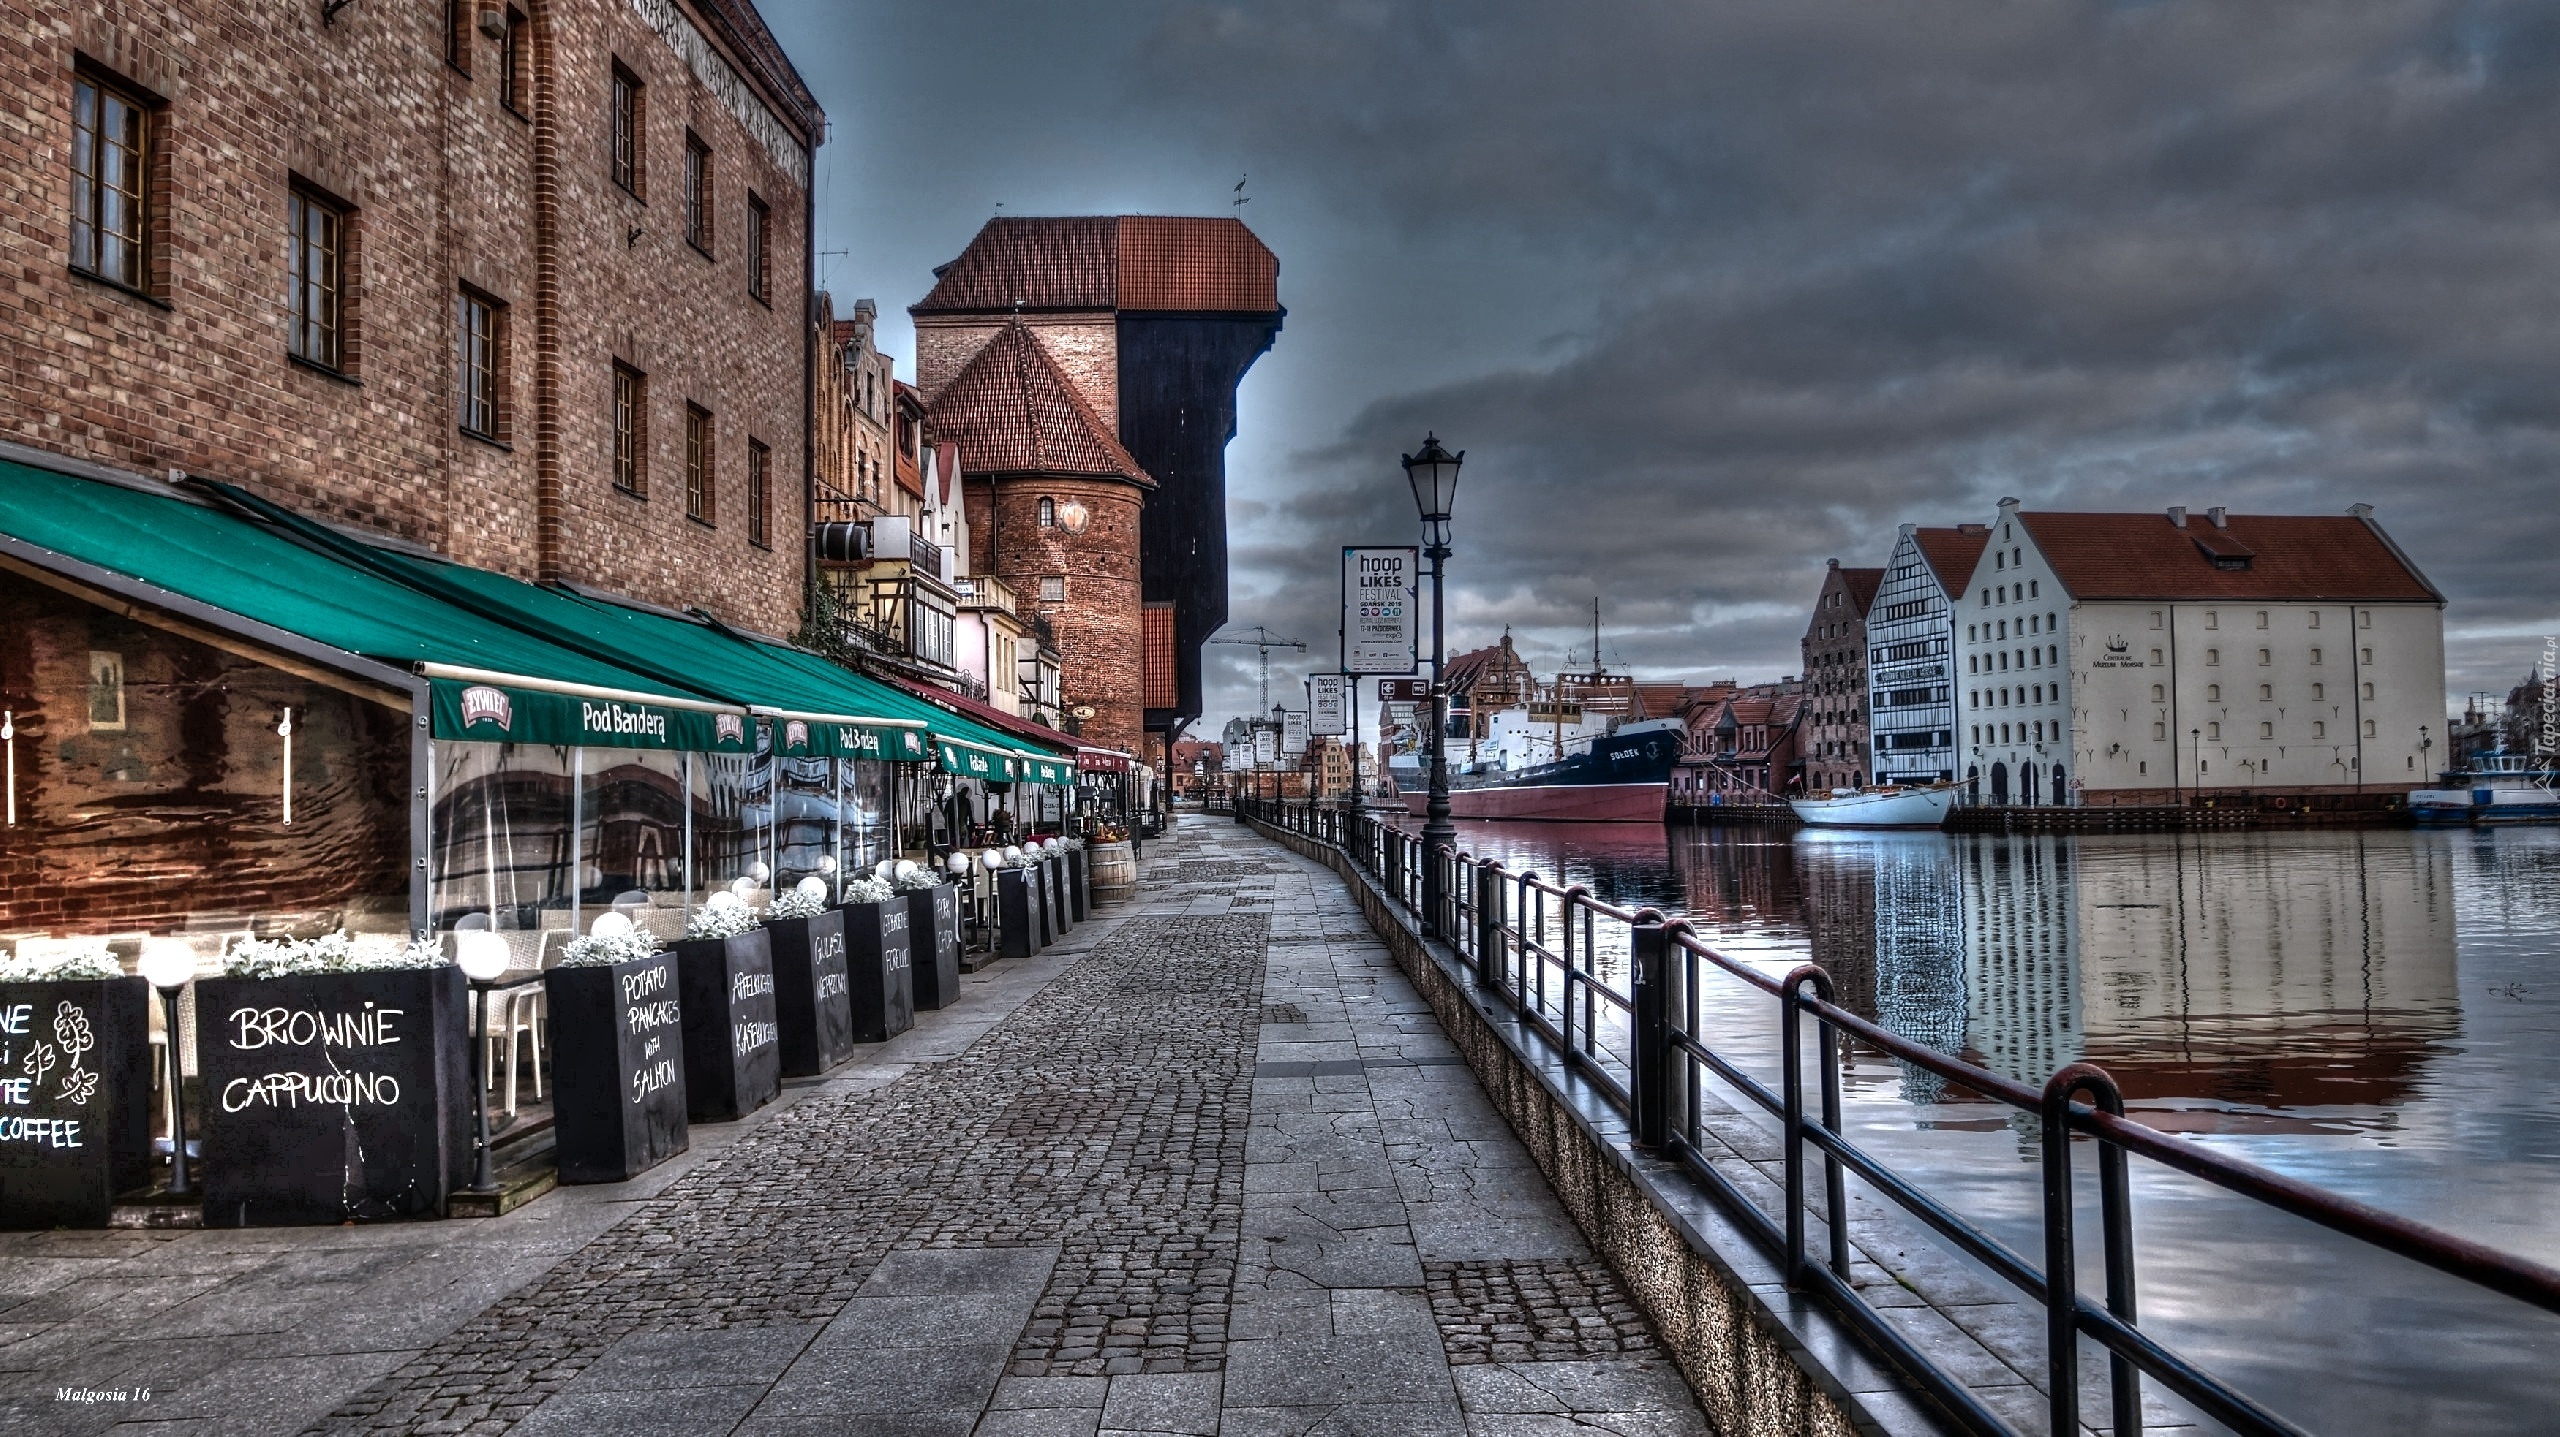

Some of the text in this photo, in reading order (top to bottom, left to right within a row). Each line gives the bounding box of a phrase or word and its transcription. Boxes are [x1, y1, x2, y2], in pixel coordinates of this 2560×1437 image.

[1359, 589, 1401, 600] FESTIVAL
[1360, 576, 1402, 587] LIKES
[466, 689, 506, 717] ŻYWIEC
[582, 702, 666, 743] Pod Banderą
[1609, 748, 1640, 761] SOŁDEK
[814, 931, 844, 965] GULASZ
[622, 965, 667, 1005] POTATO
[627, 1000, 680, 1035] PANCAKES
[631, 1058, 676, 1104] SALMON
[0, 1115, 83, 1149] COFFEE
